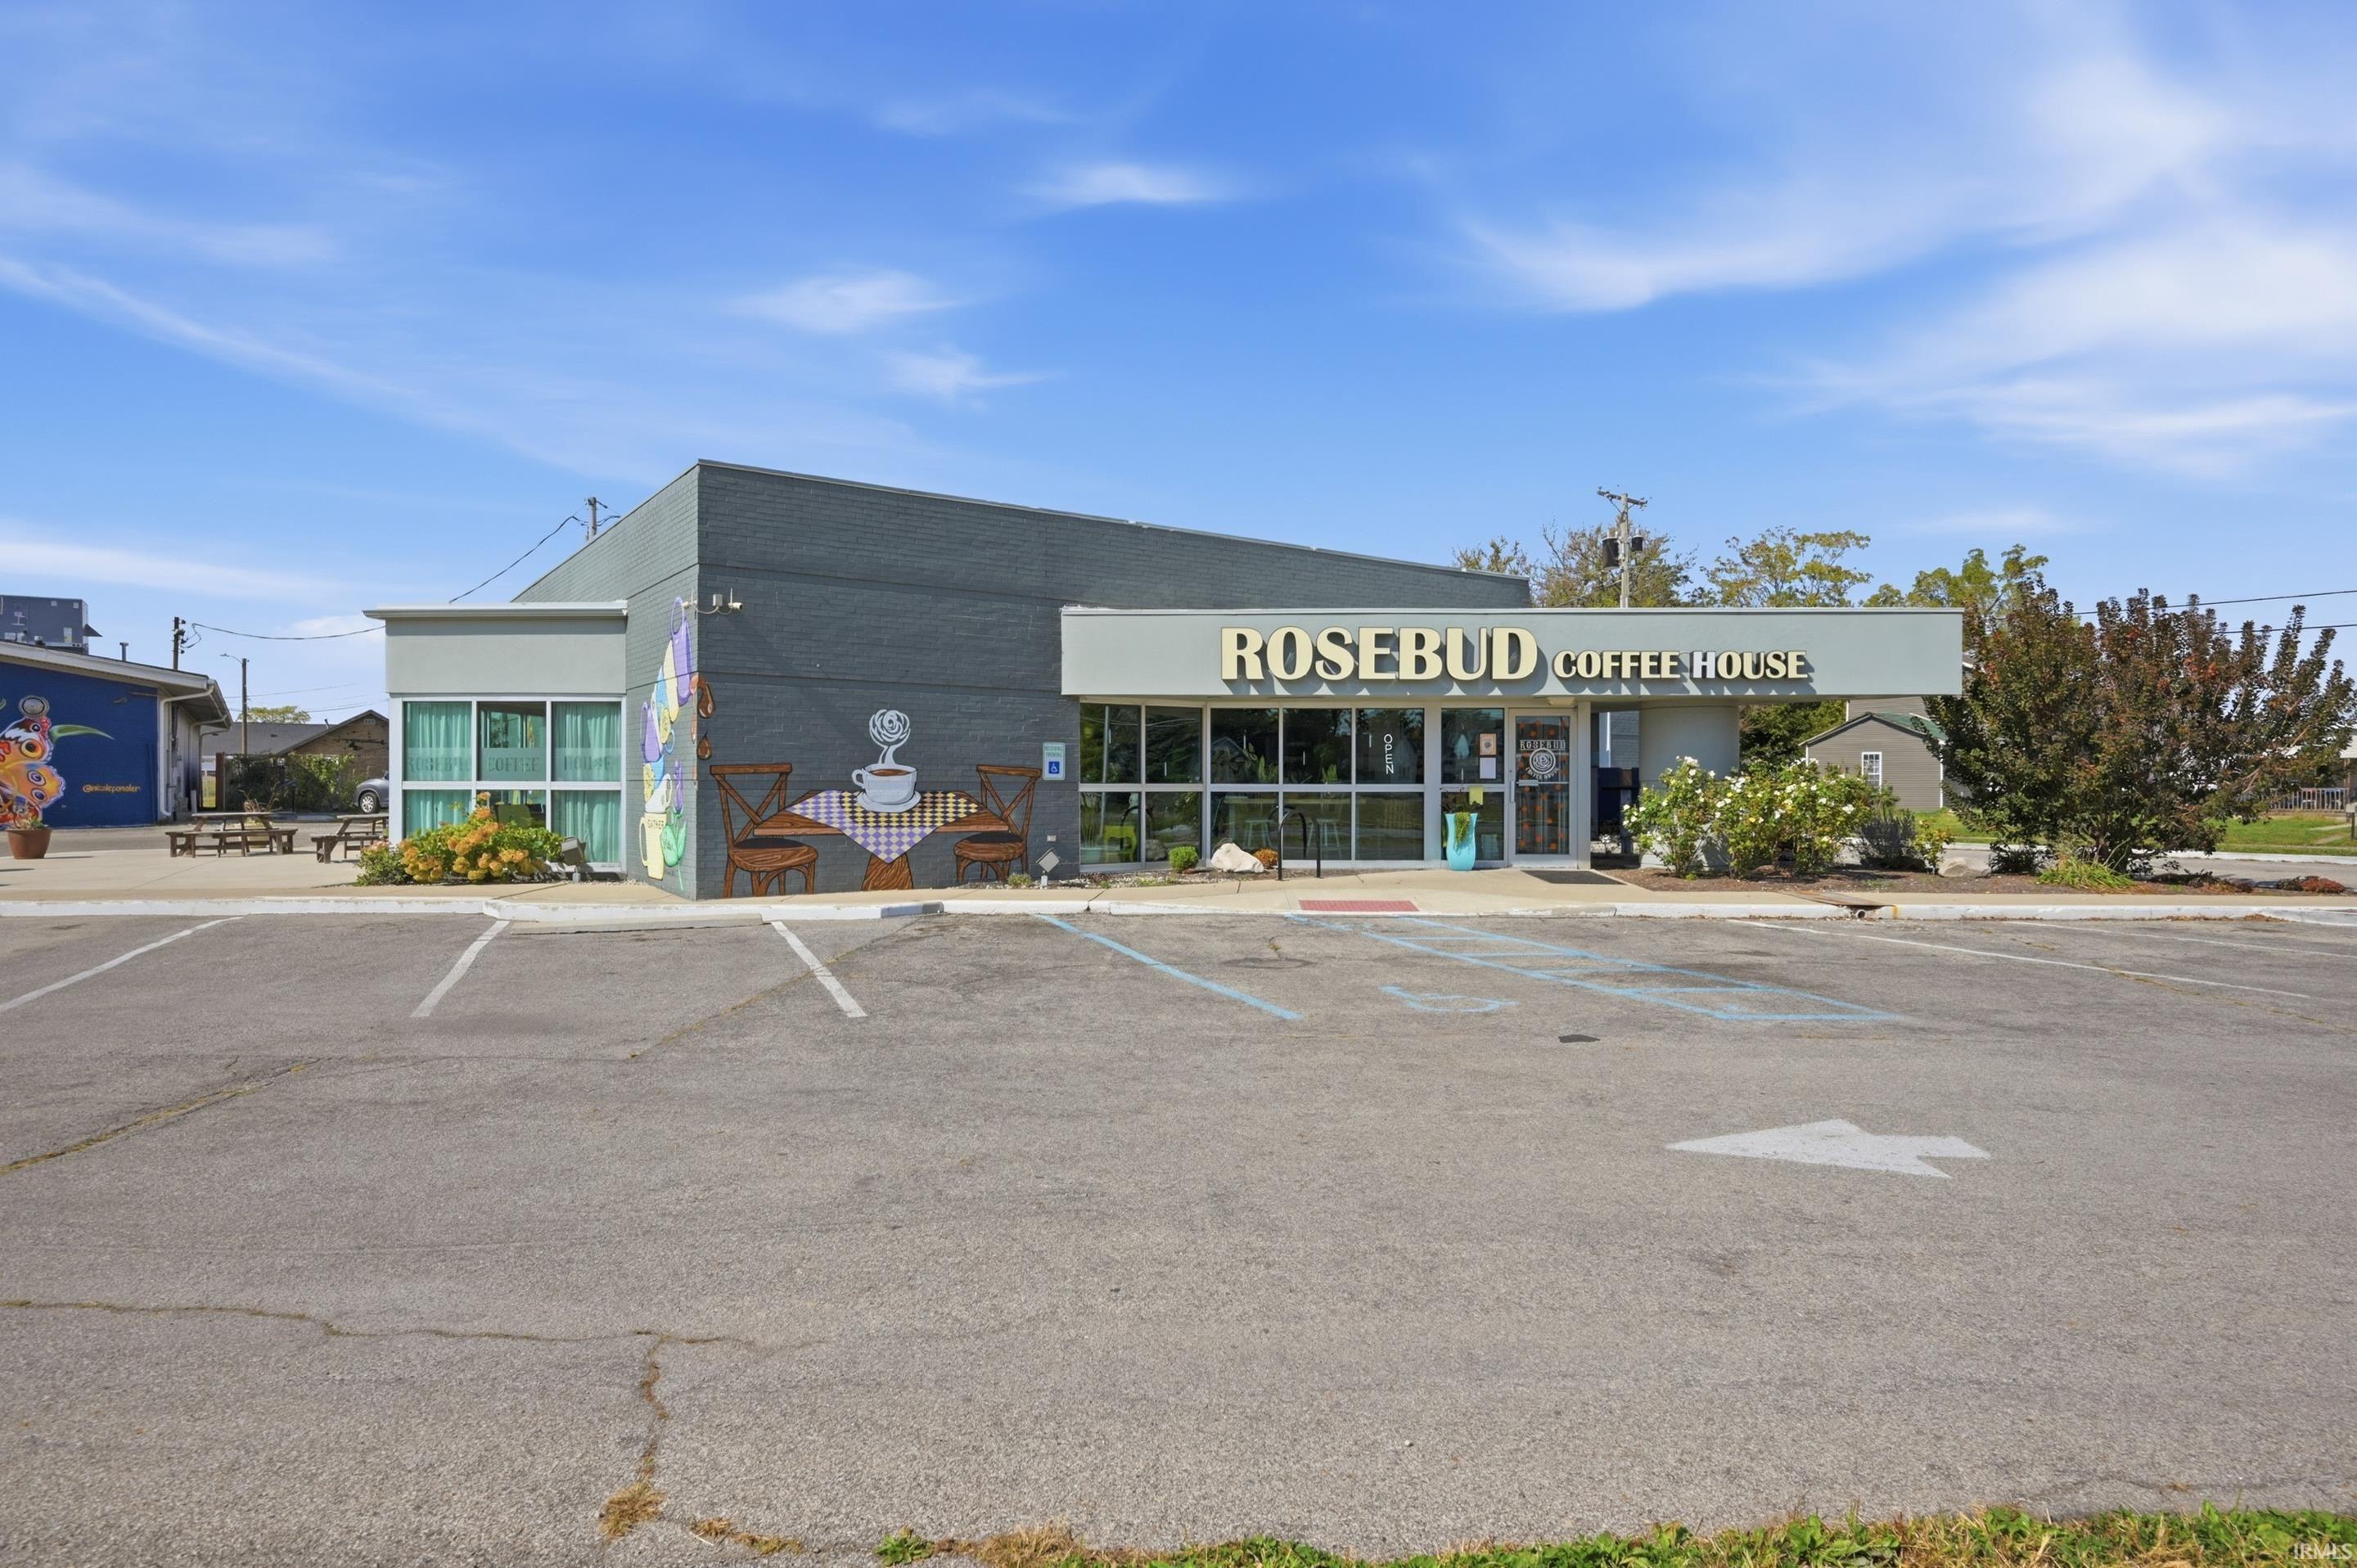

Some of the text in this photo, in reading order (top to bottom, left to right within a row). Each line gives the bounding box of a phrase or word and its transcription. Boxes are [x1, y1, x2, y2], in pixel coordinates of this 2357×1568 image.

[1221, 626, 1808, 680] ROSEBUD COFFEE HOUSE
[1383, 733, 1394, 774] OPEN
[1520, 739, 1566, 750] ROSEBUD
[489, 756, 540, 772] COFFEE
[564, 755, 612, 771] HOUSE
